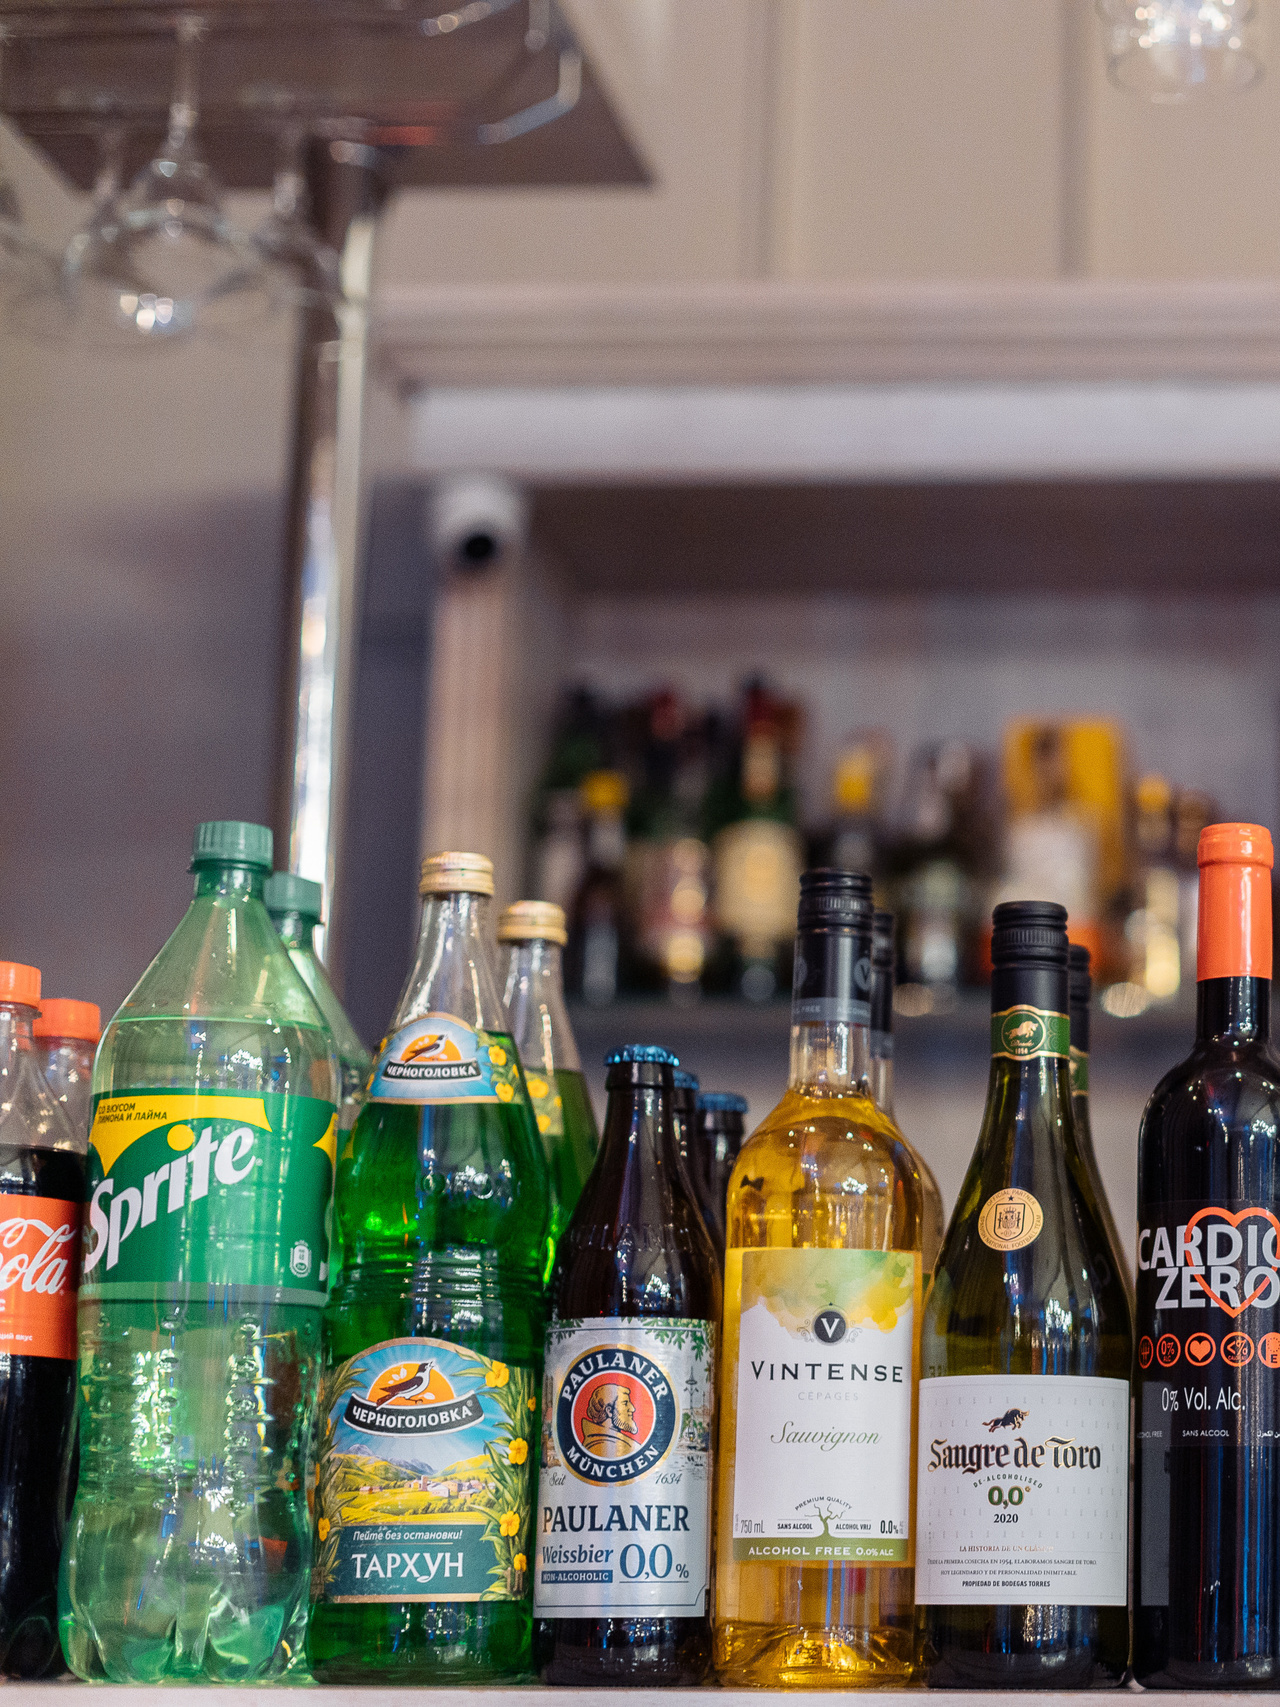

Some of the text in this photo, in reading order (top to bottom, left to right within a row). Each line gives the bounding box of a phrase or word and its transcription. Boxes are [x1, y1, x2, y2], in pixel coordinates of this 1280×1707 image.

[386, 1064, 477, 1078] ЧЕРНОГОЛОВКА
[106, 1102, 136, 1114] ВКУСОМ
[126, 1112, 133, 1121] И
[133, 1109, 168, 1121] ЛАЙМА
[84, 1124, 257, 1274] Sprite
[0, 1218, 77, 1295] ola
[1154, 1265, 1280, 1310] ZERO
[820, 1317, 840, 1339] V
[1160, 1340, 1175, 1355] 0%
[563, 1352, 670, 1401] PAULANER
[750, 1360, 903, 1383] VINTENSE
[1161, 1385, 1246, 1412] 0% Vol. Alc.
[352, 1404, 473, 1429] ЧЕРНОГОЛОВКА
[770, 1421, 883, 1452] Sauvignon
[1200, 1429, 1230, 1437] ALCOOL
[565, 1444, 660, 1479] MÜNCHEN
[927, 1435, 1102, 1475] Sangre de Toro
[548, 1471, 683, 1487] Seit 1634
[972, 1473, 1043, 1490] DE-ALCOHOLISED
[794, 1495, 852, 1511] PREMIUM QUALITY
[542, 1504, 691, 1533] PAULANER
[740, 1519, 752, 1534] 750
[753, 1519, 765, 1534] mL
[993, 1513, 1019, 1524] 2020
[353, 1529, 463, 1541] Пейте без остановки!
[835, 1523, 859, 1531] ALCOHOL
[880, 1519, 899, 1535] 0.0%
[542, 1544, 614, 1564] Weissbier
[748, 1546, 894, 1557] ALCOHOL FREE 0.0% ALC
[350, 1551, 464, 1584] ТАРХУН
[542, 1571, 609, 1582] NON-ALCOHOLIC
[962, 1580, 1051, 1588] PROPIEDAD DE BODEGAS TORRES
